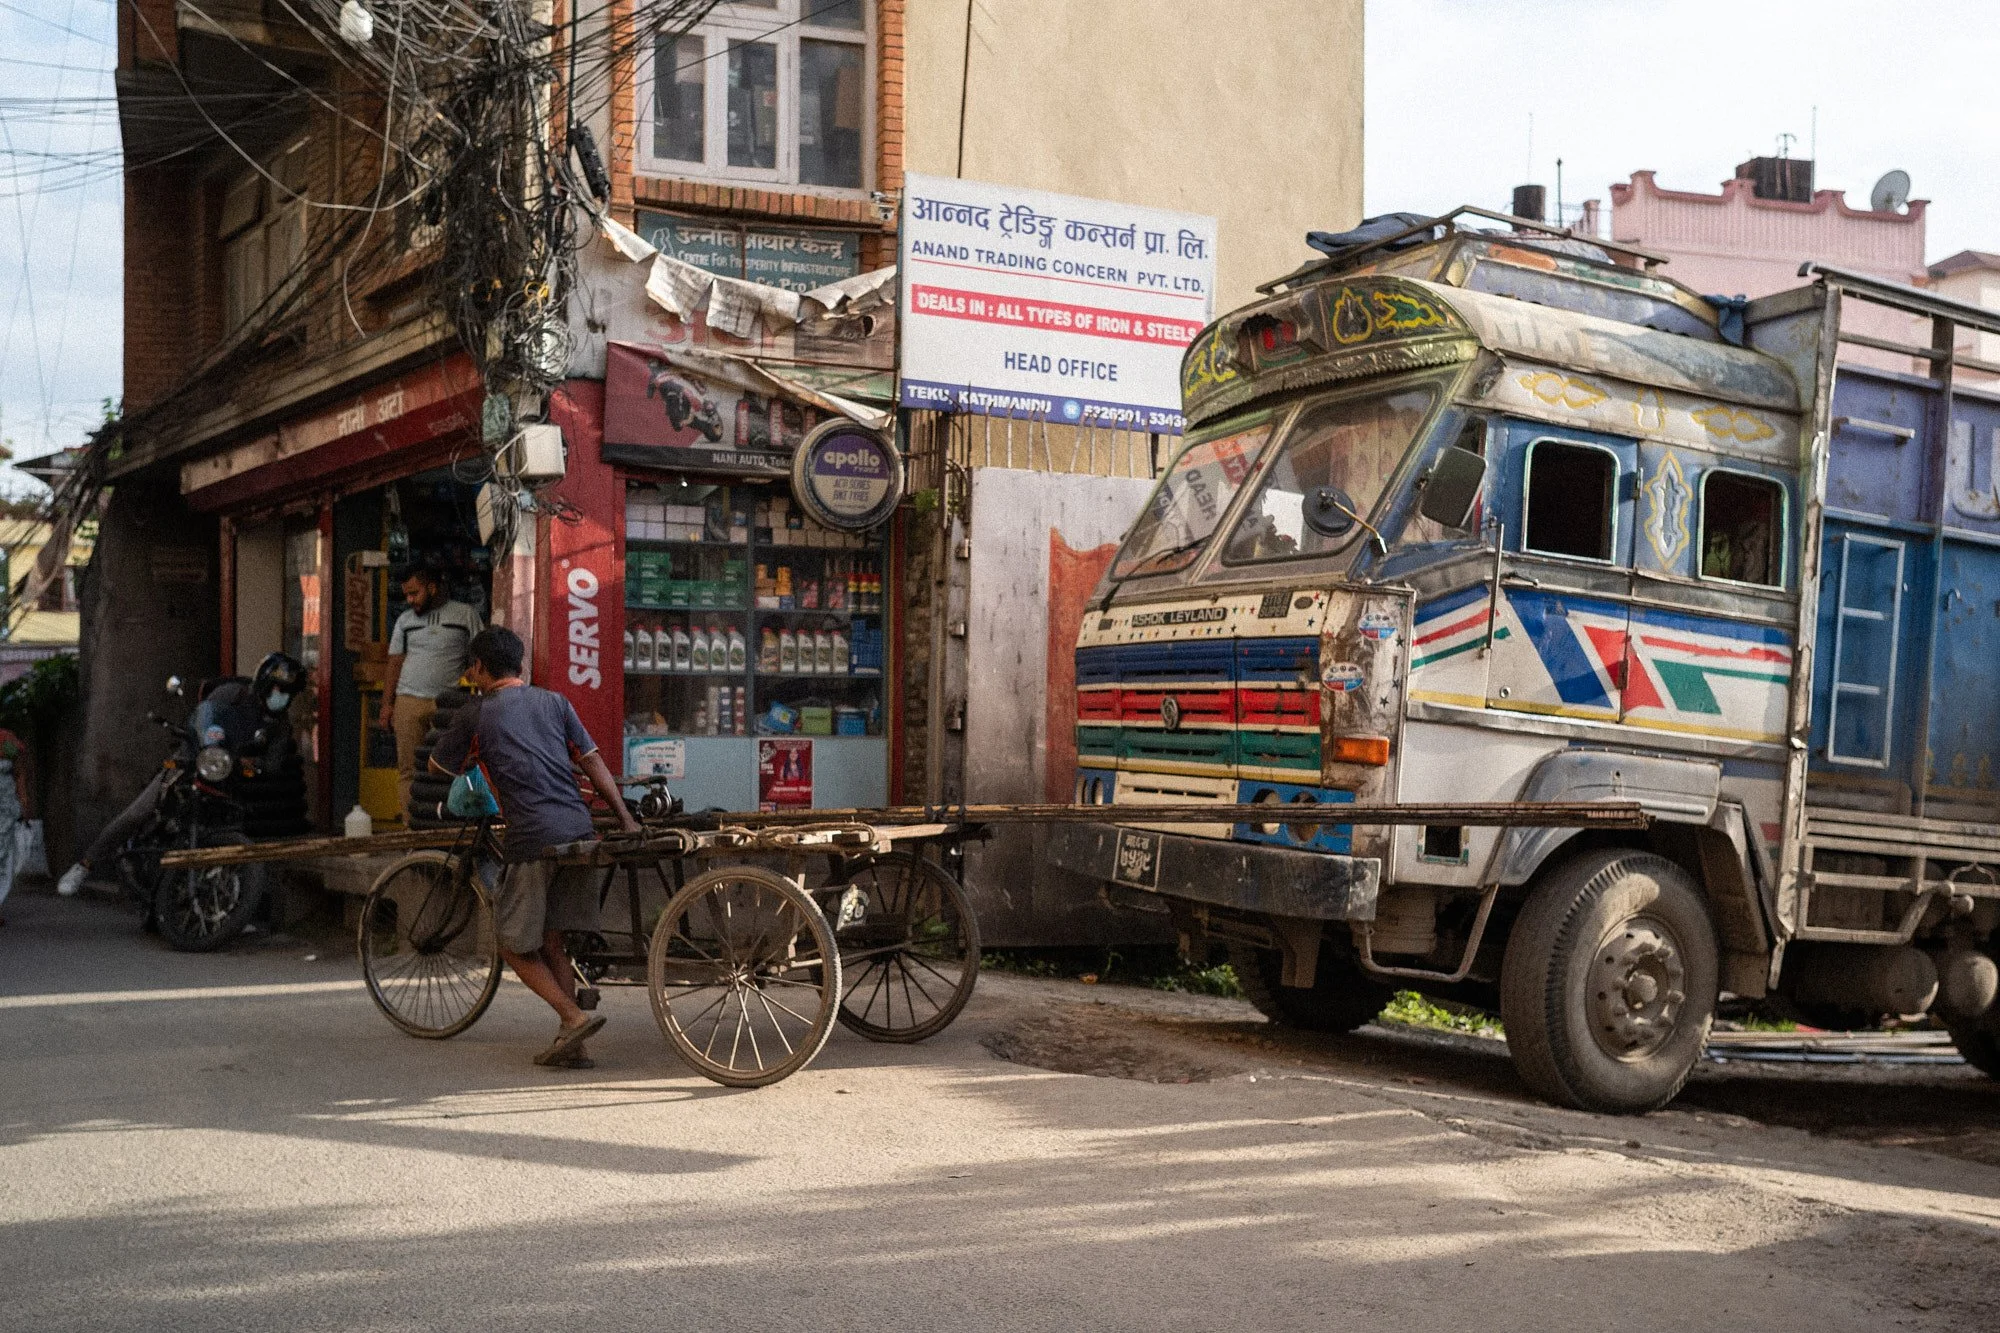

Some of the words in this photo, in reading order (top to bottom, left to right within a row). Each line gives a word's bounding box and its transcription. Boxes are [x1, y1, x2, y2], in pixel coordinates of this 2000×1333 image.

[1178, 229, 1208, 260] लि.
[911, 240, 969, 261] ANAND
[975, 249, 1047, 271] TRADING
[1053, 259, 1128, 283] CONCERN
[1137, 272, 1169, 289] PVT.
[1174, 277, 1205, 293] LTD.
[917, 292, 965, 314] DEALS
[996, 300, 1023, 321] ALL
[1027, 307, 1072, 327] TYPES
[1074, 313, 1094, 331] OF
[1096, 316, 1130, 335] IRON
[1133, 320, 1144, 337] &
[1003, 352, 1051, 373] HEAD
[1058, 357, 1118, 381] OFFICE
[958, 390, 1052, 413] KATHMANDU
[712, 453, 737, 465] NANI
[824, 449, 881, 469] apollo
[567, 567, 602, 690] SERVO
[1132, 613, 1165, 627] ASHOK
[1170, 608, 1224, 623] LEYLAND
